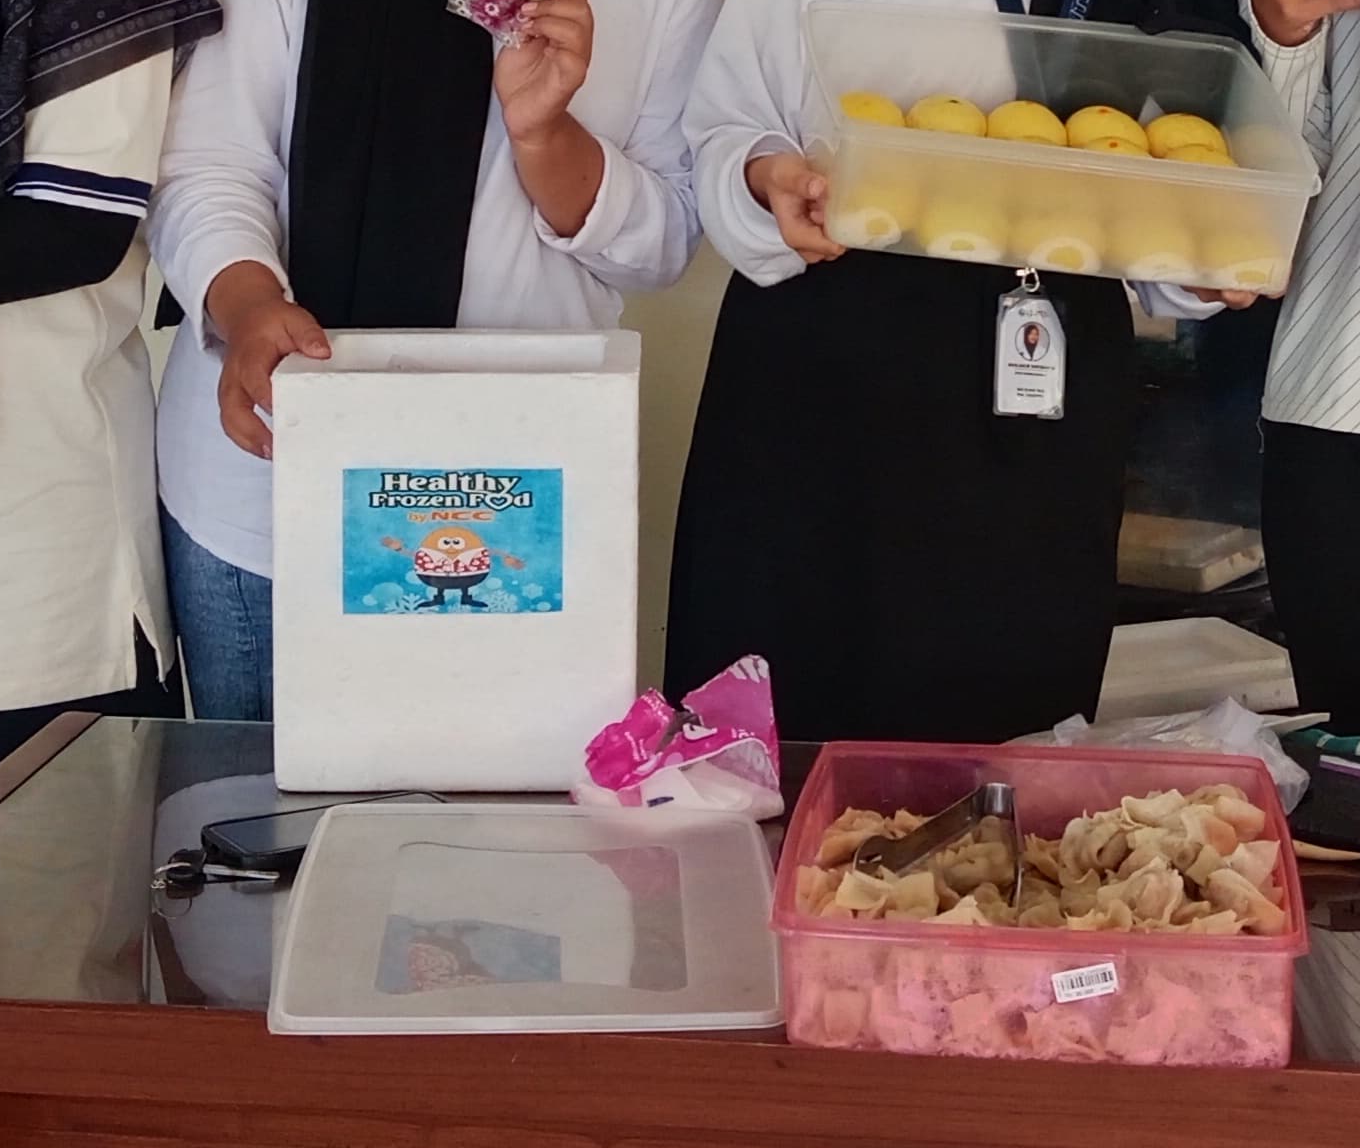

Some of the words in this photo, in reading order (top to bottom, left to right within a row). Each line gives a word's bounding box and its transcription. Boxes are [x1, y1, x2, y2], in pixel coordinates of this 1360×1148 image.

[381, 471, 522, 497] Healthy
[369, 491, 464, 508] Frozen
[408, 511, 428, 523] by
[430, 511, 494, 521] NCC
